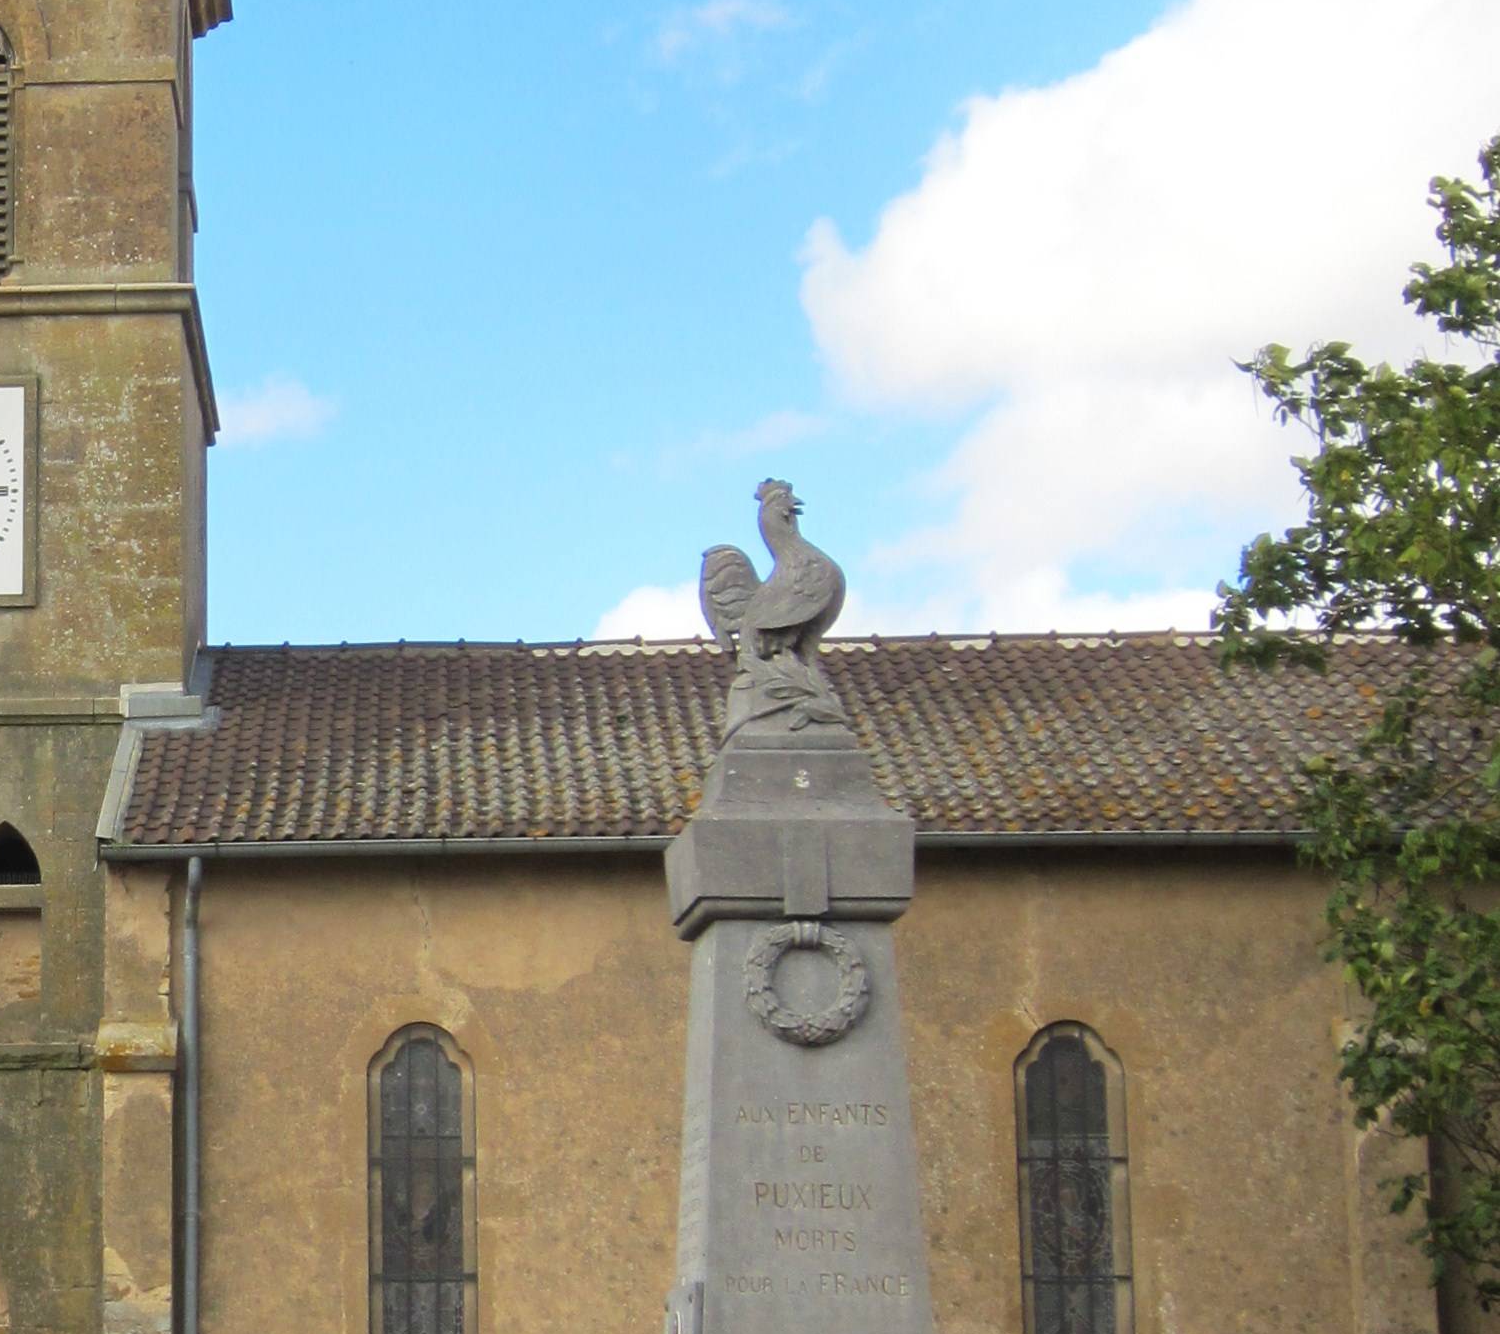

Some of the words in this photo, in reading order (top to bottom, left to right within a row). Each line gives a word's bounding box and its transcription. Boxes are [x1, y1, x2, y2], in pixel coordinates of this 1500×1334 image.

[735, 1104, 774, 1125] AUX
[787, 1102, 887, 1126] ENFANTS
[799, 1144, 825, 1163] DE
[754, 1181, 872, 1211] PUXIEUX
[774, 1228, 856, 1252] MORTS
[725, 1274, 772, 1294] POUR
[786, 1277, 807, 1295] LA
[819, 1273, 910, 1297] FRANCE
